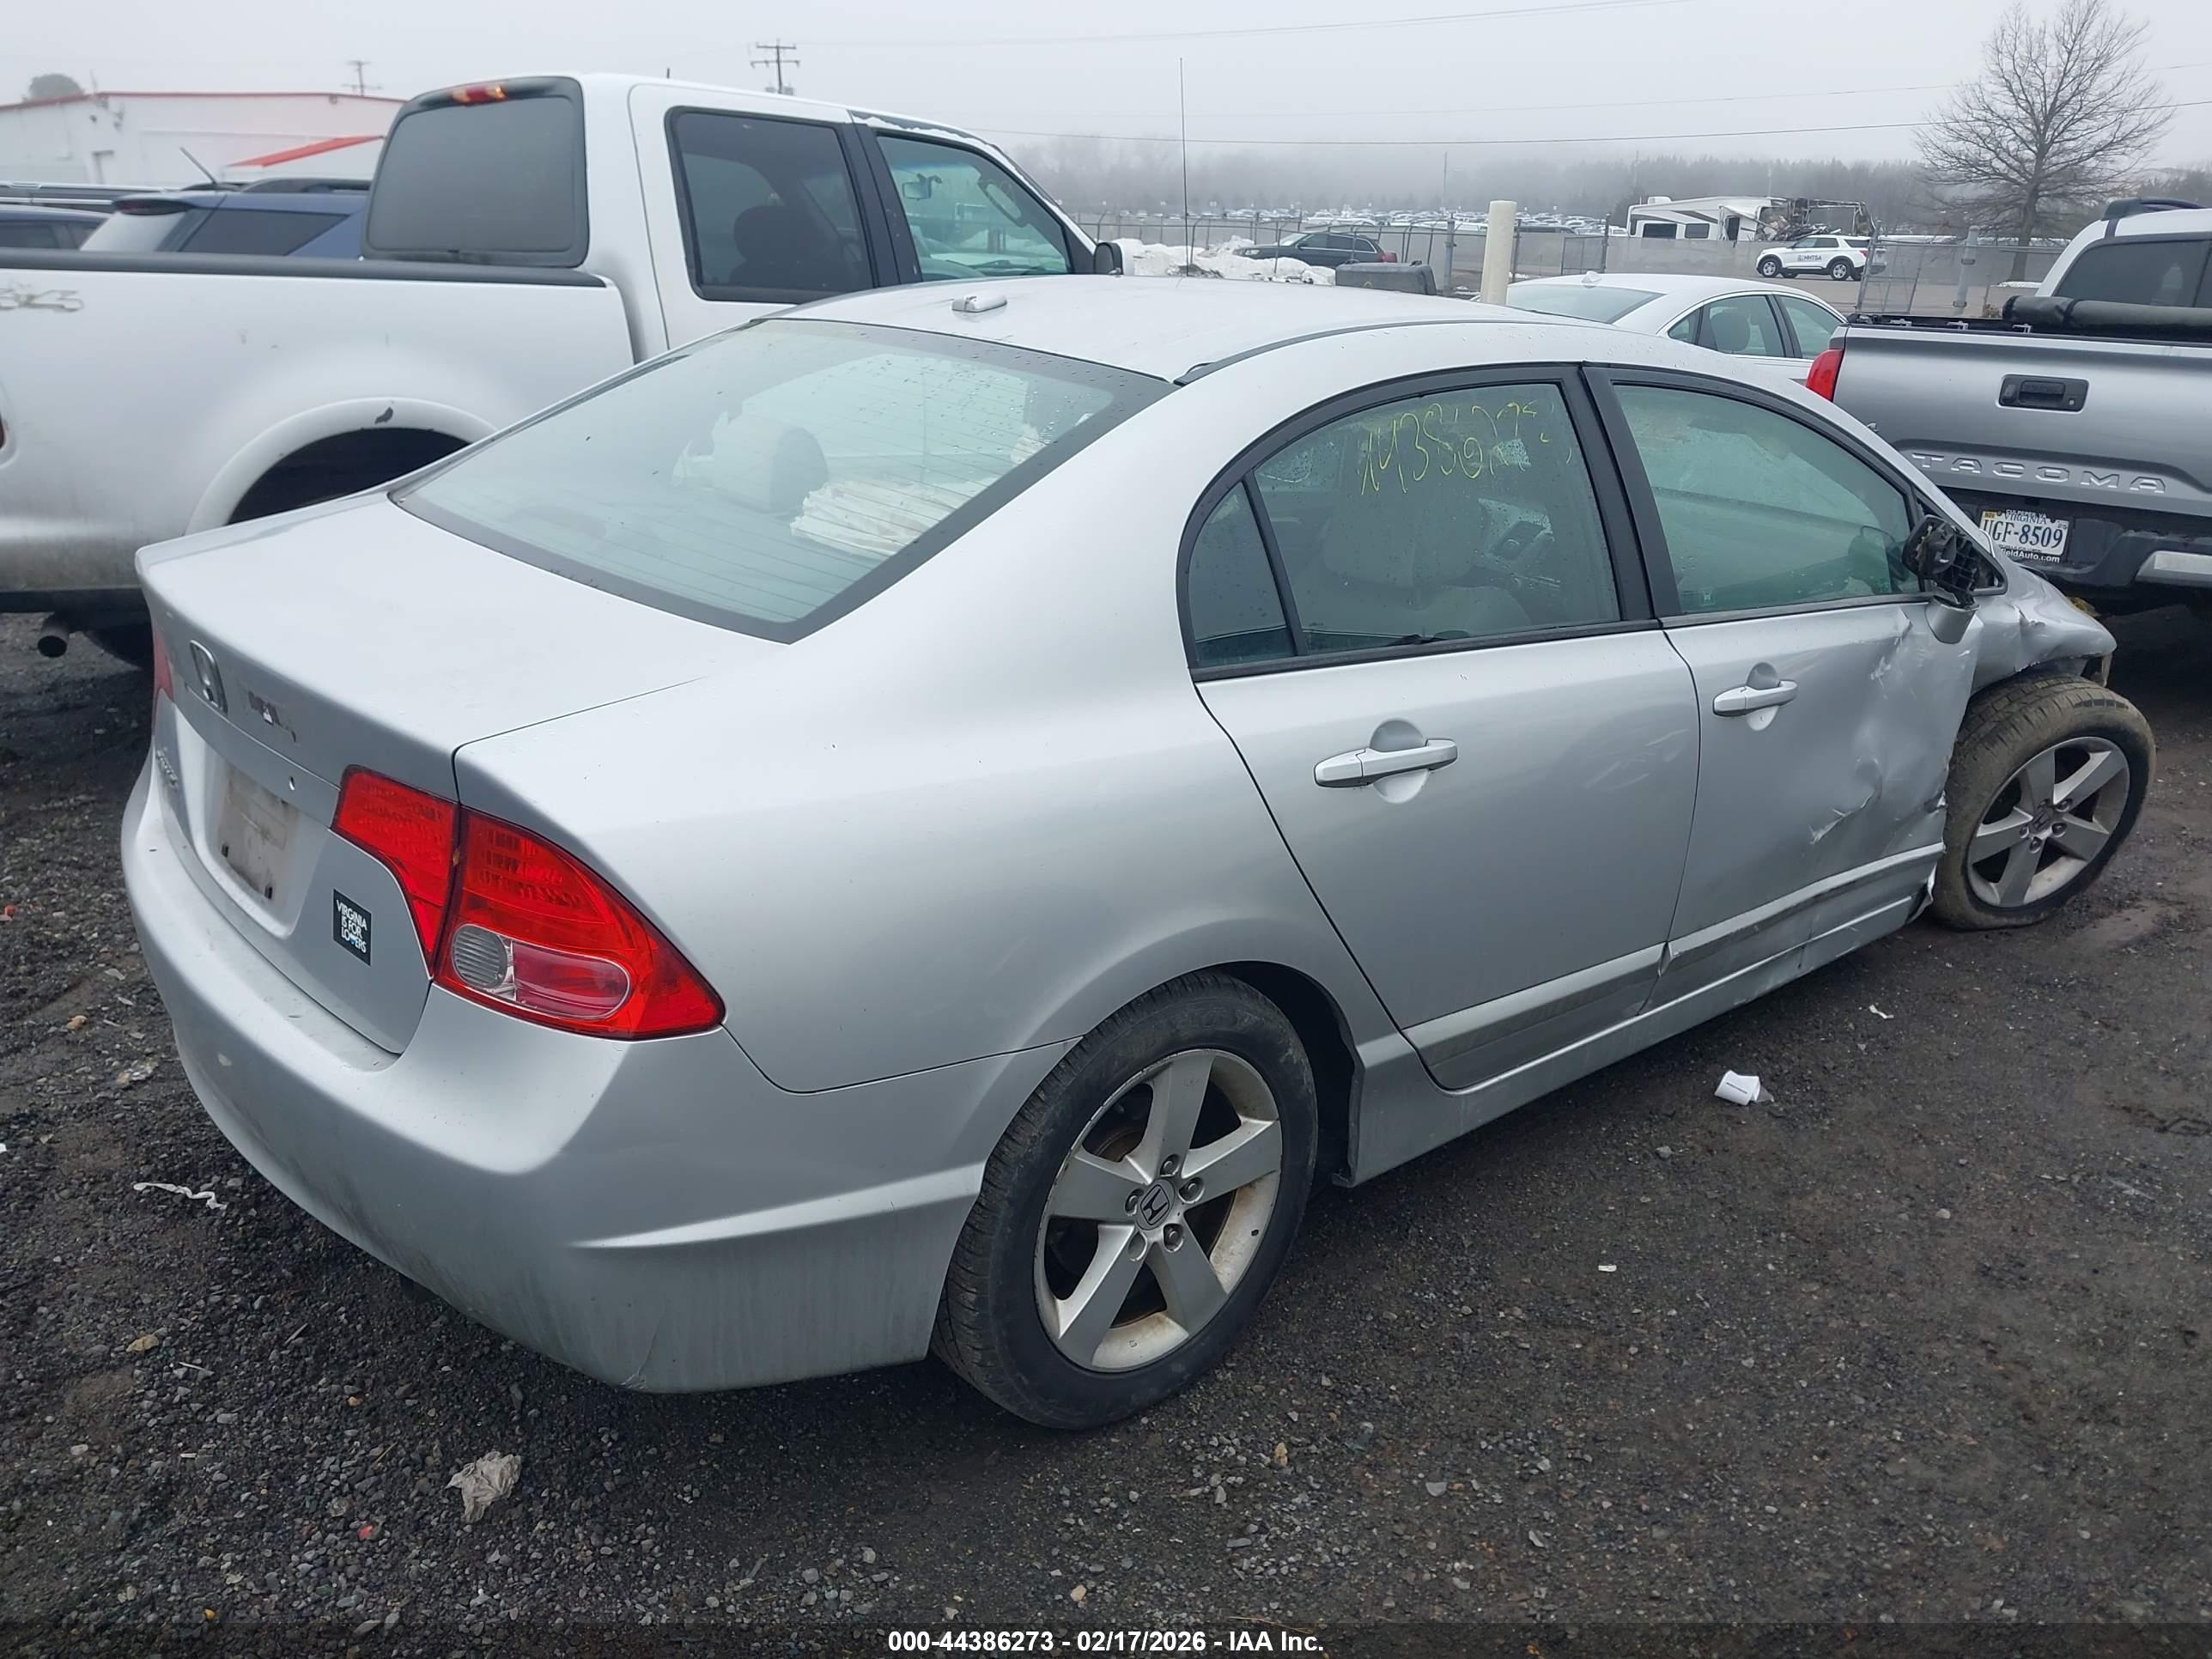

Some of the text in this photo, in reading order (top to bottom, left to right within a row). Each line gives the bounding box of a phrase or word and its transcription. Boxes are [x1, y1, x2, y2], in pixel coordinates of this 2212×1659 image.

[1911, 453, 2166, 494] TACOMA
[2004, 513, 2047, 525] VIRGINIA
[1983, 519, 2063, 549] UGF-8509
[2001, 548, 2060, 563] ieldAuto.com
[336, 899, 368, 931] VIRGINIA
[341, 915, 363, 939] IS FOR
